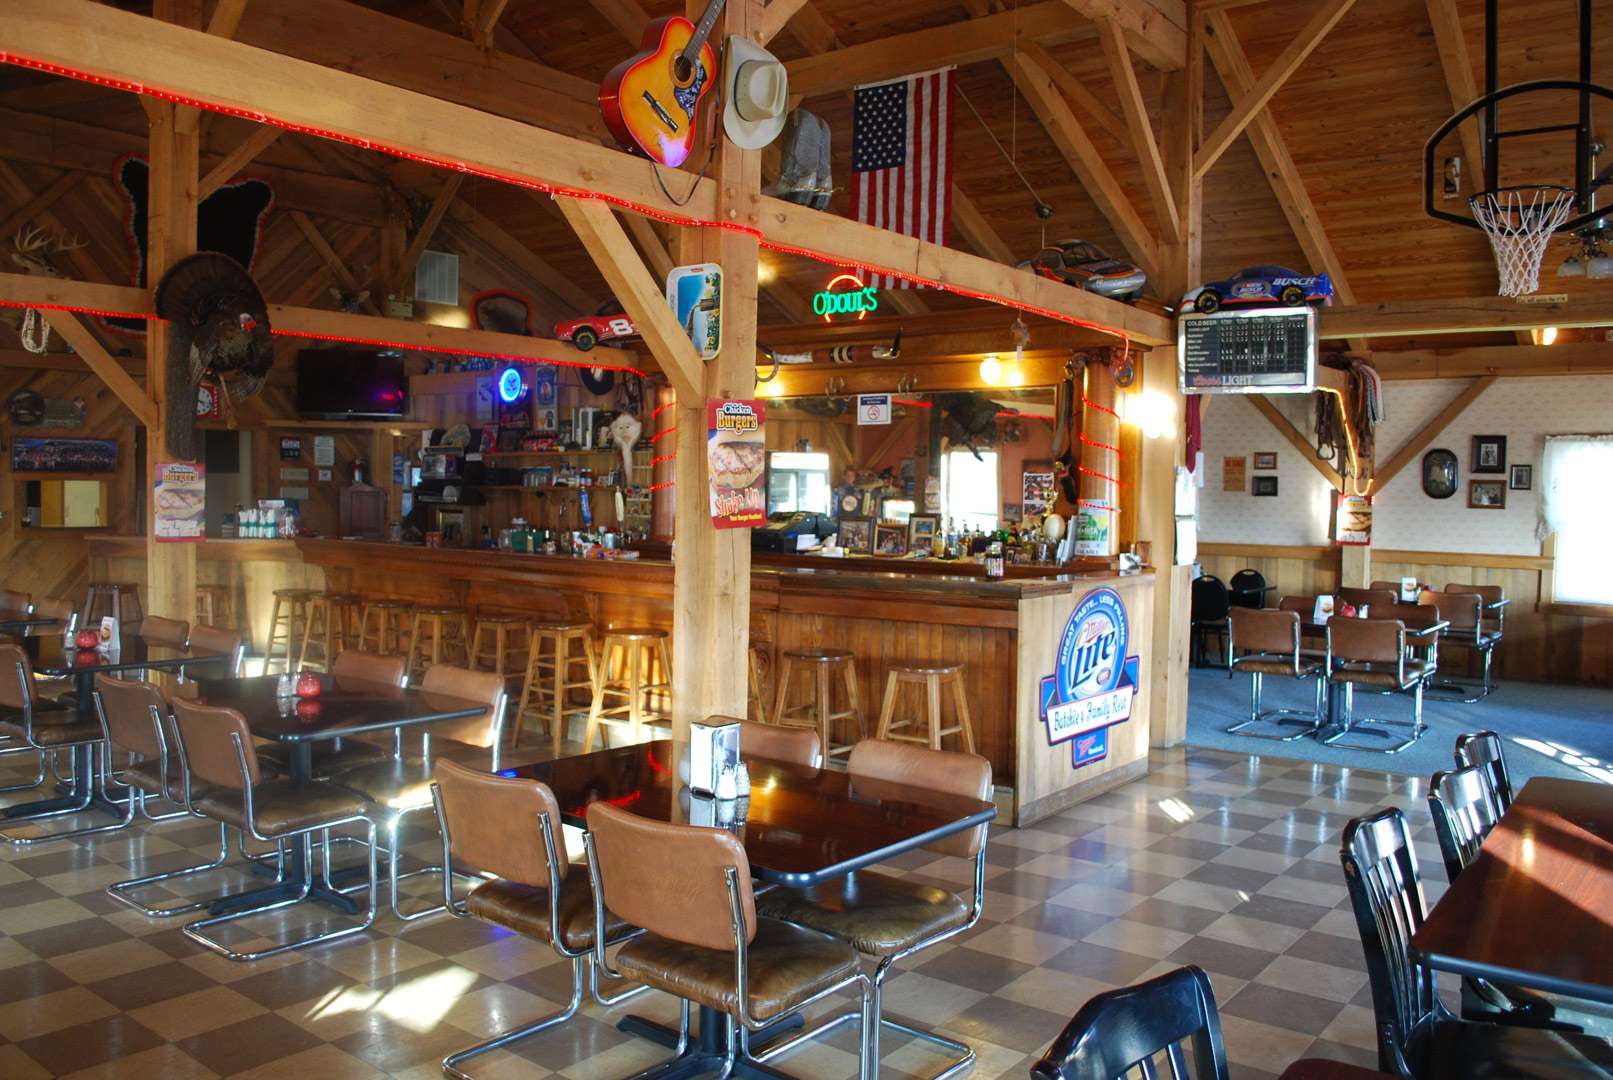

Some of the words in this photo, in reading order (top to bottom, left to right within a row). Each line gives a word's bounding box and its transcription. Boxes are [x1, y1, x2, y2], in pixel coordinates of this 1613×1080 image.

[1272, 277, 1316, 287] BUSCH
[609, 318, 633, 336] 8
[1222, 375, 1254, 386] LIGHT
[724, 403, 752, 414] Chicken
[718, 410, 757, 433] Burgers
[1061, 623, 1075, 665] GREAT
[1099, 595, 1115, 606] LESS
[1113, 603, 1125, 646] FILLING
[1071, 630, 1115, 688] Lite
[1087, 697, 1111, 722] Family
[1112, 694, 1127, 713] Rest
